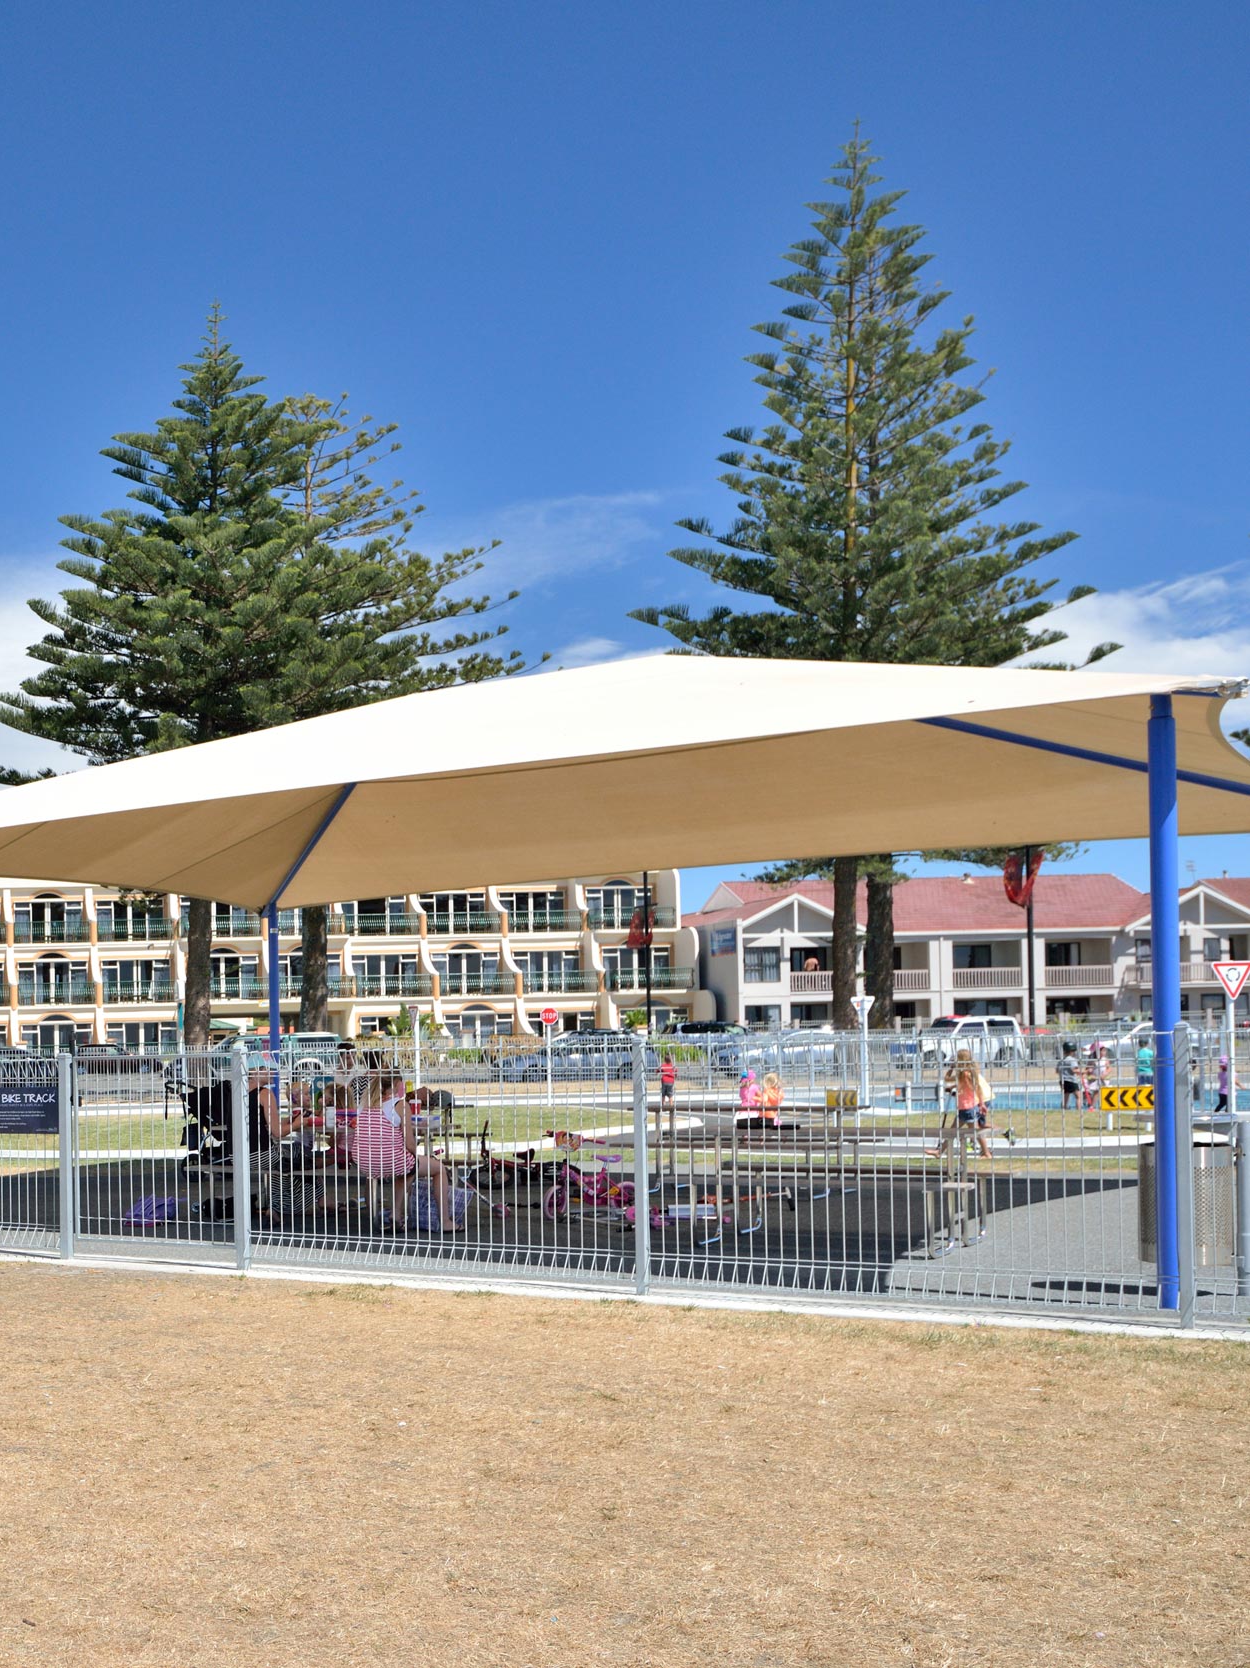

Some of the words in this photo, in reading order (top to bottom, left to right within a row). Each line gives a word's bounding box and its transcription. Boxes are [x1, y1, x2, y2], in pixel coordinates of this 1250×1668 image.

[542, 1012, 557, 1020] STOP
[1, 1093, 21, 1103] BIKE
[23, 1093, 56, 1103] TRACK
